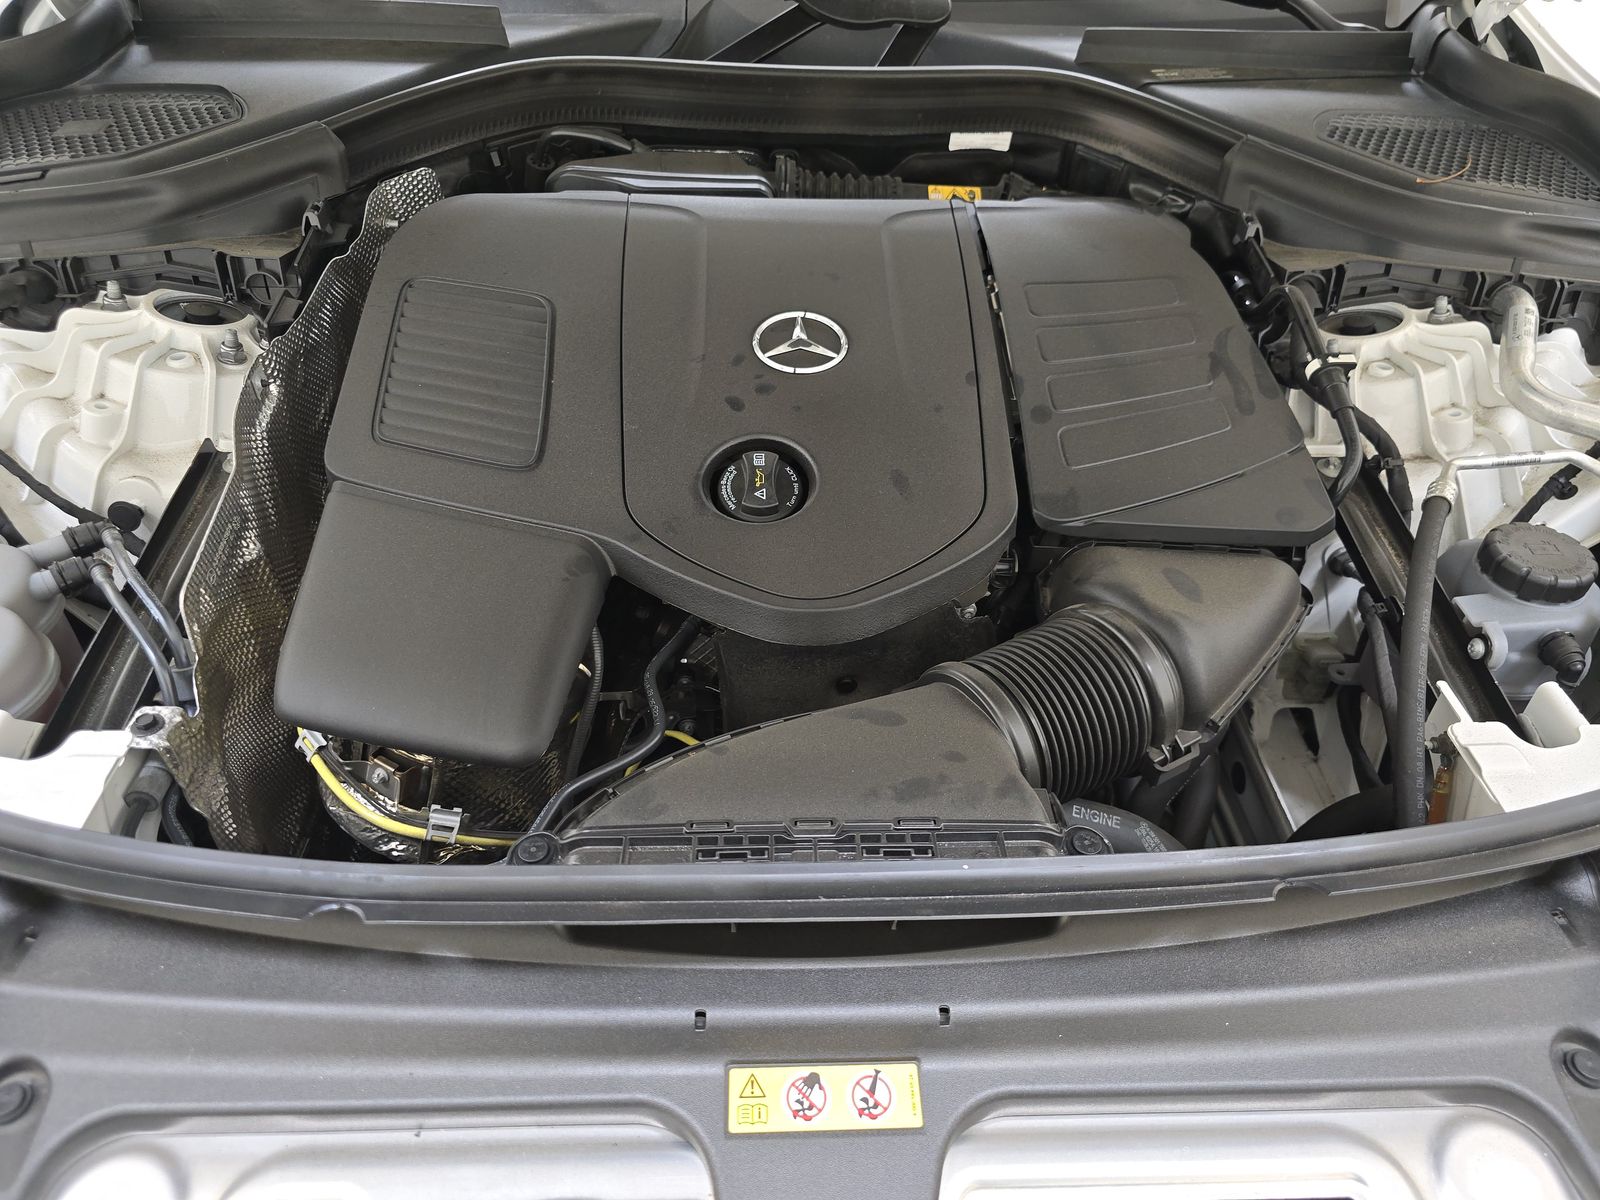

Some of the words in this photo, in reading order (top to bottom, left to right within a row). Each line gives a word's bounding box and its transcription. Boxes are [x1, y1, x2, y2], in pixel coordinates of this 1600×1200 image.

[720, 471, 737, 510] Mercedes-Benz
[786, 495, 797, 507] Turn
[1072, 804, 1121, 829] ENGINE
